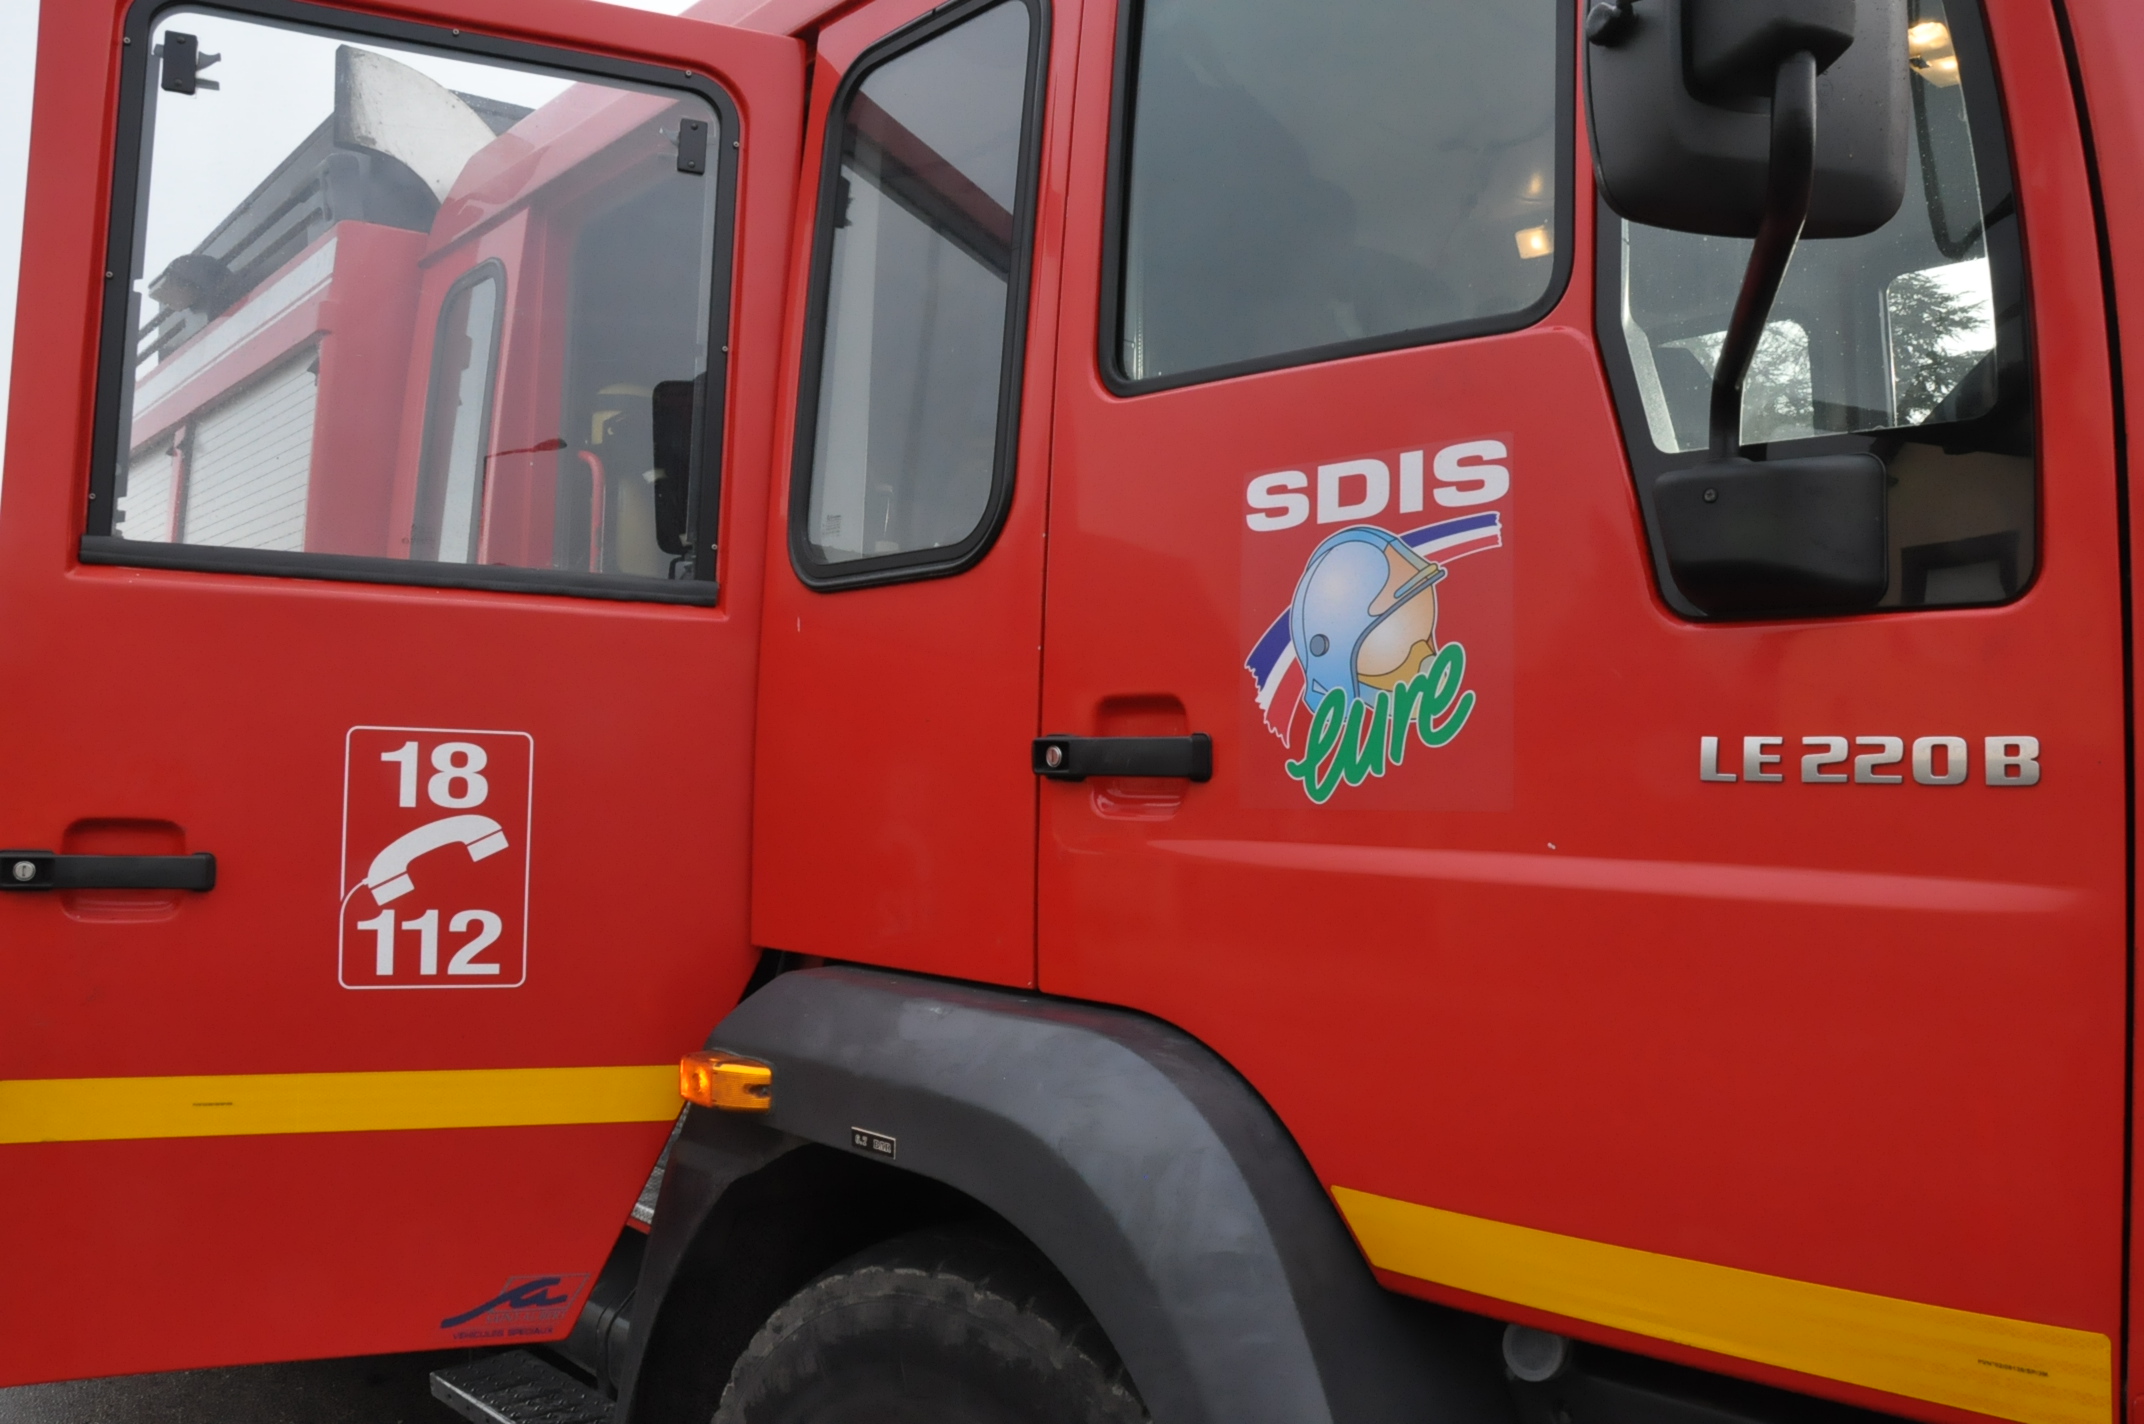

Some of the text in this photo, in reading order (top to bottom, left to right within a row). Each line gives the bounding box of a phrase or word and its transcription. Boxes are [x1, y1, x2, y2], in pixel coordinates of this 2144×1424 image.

[1245, 439, 1510, 532] SDIS
[380, 740, 489, 809] 18
[1699, 735, 2040, 786] LE 220 B
[357, 908, 503, 976] 112
